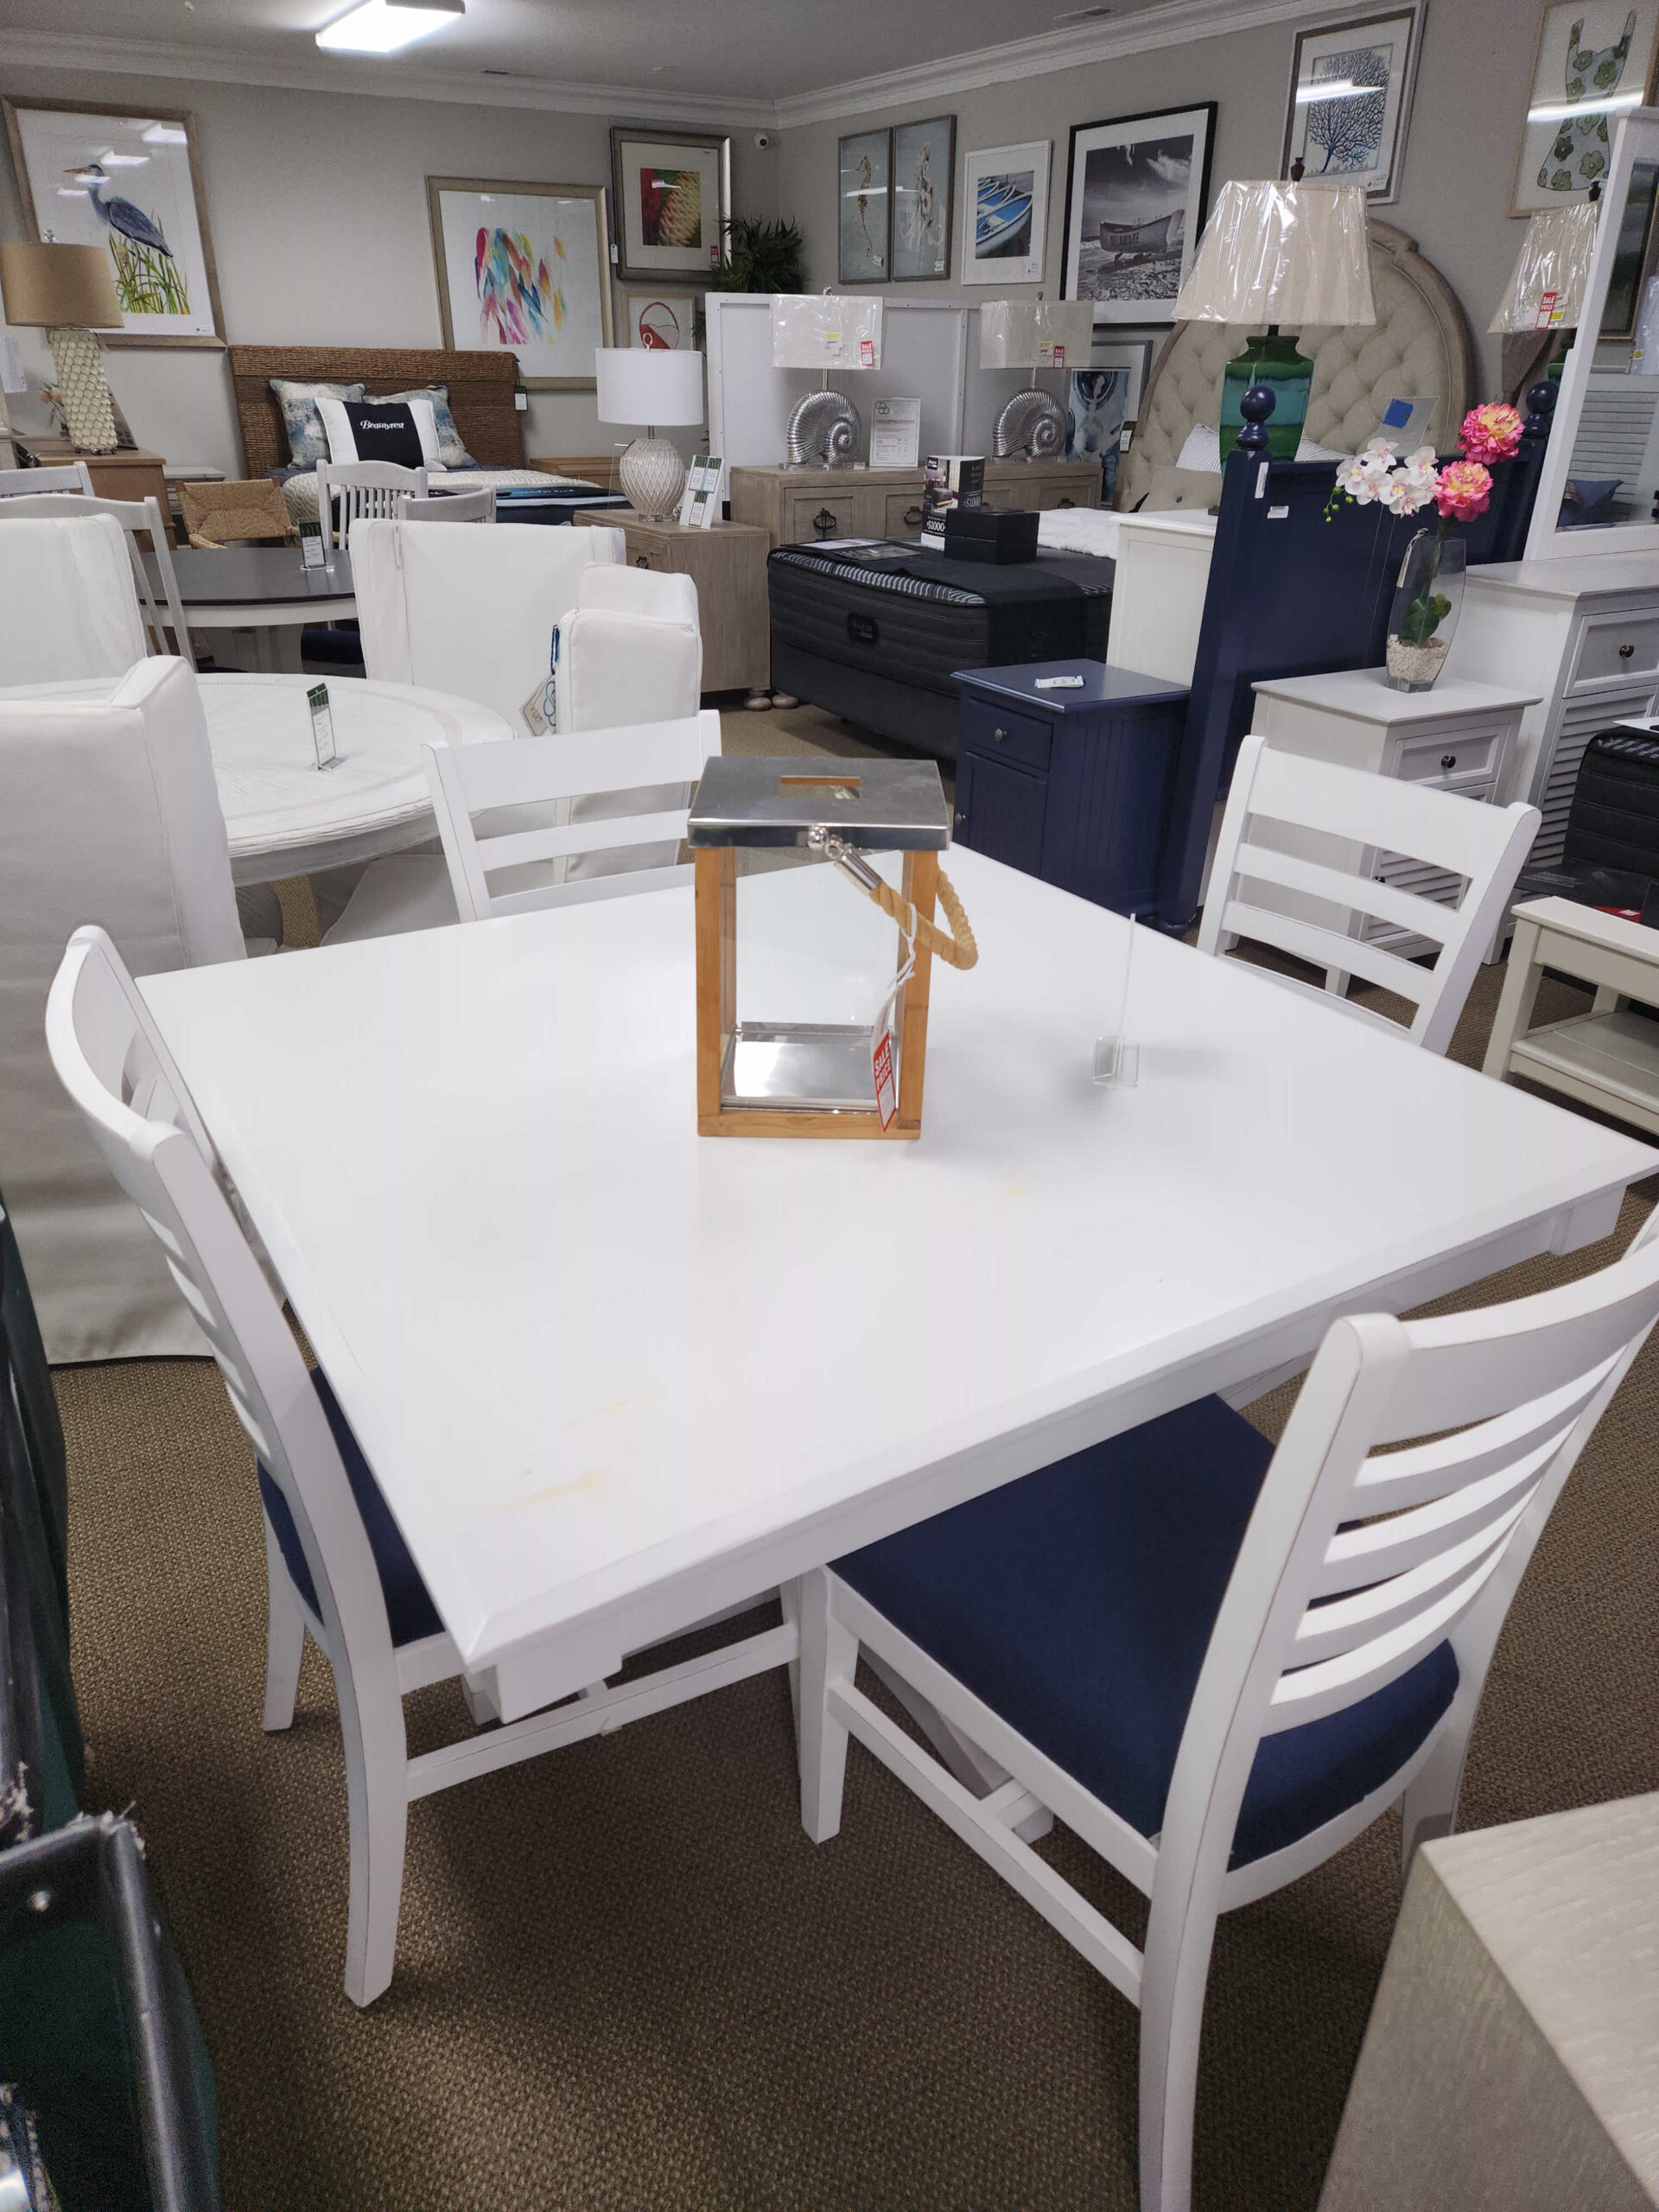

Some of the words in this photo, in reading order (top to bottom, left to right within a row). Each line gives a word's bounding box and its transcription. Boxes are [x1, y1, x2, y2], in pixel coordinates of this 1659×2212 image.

[359, 419, 404, 430] Beautyrest
[874, 1040, 890, 1076] SALE
[876, 1059, 892, 1092] PRICE
